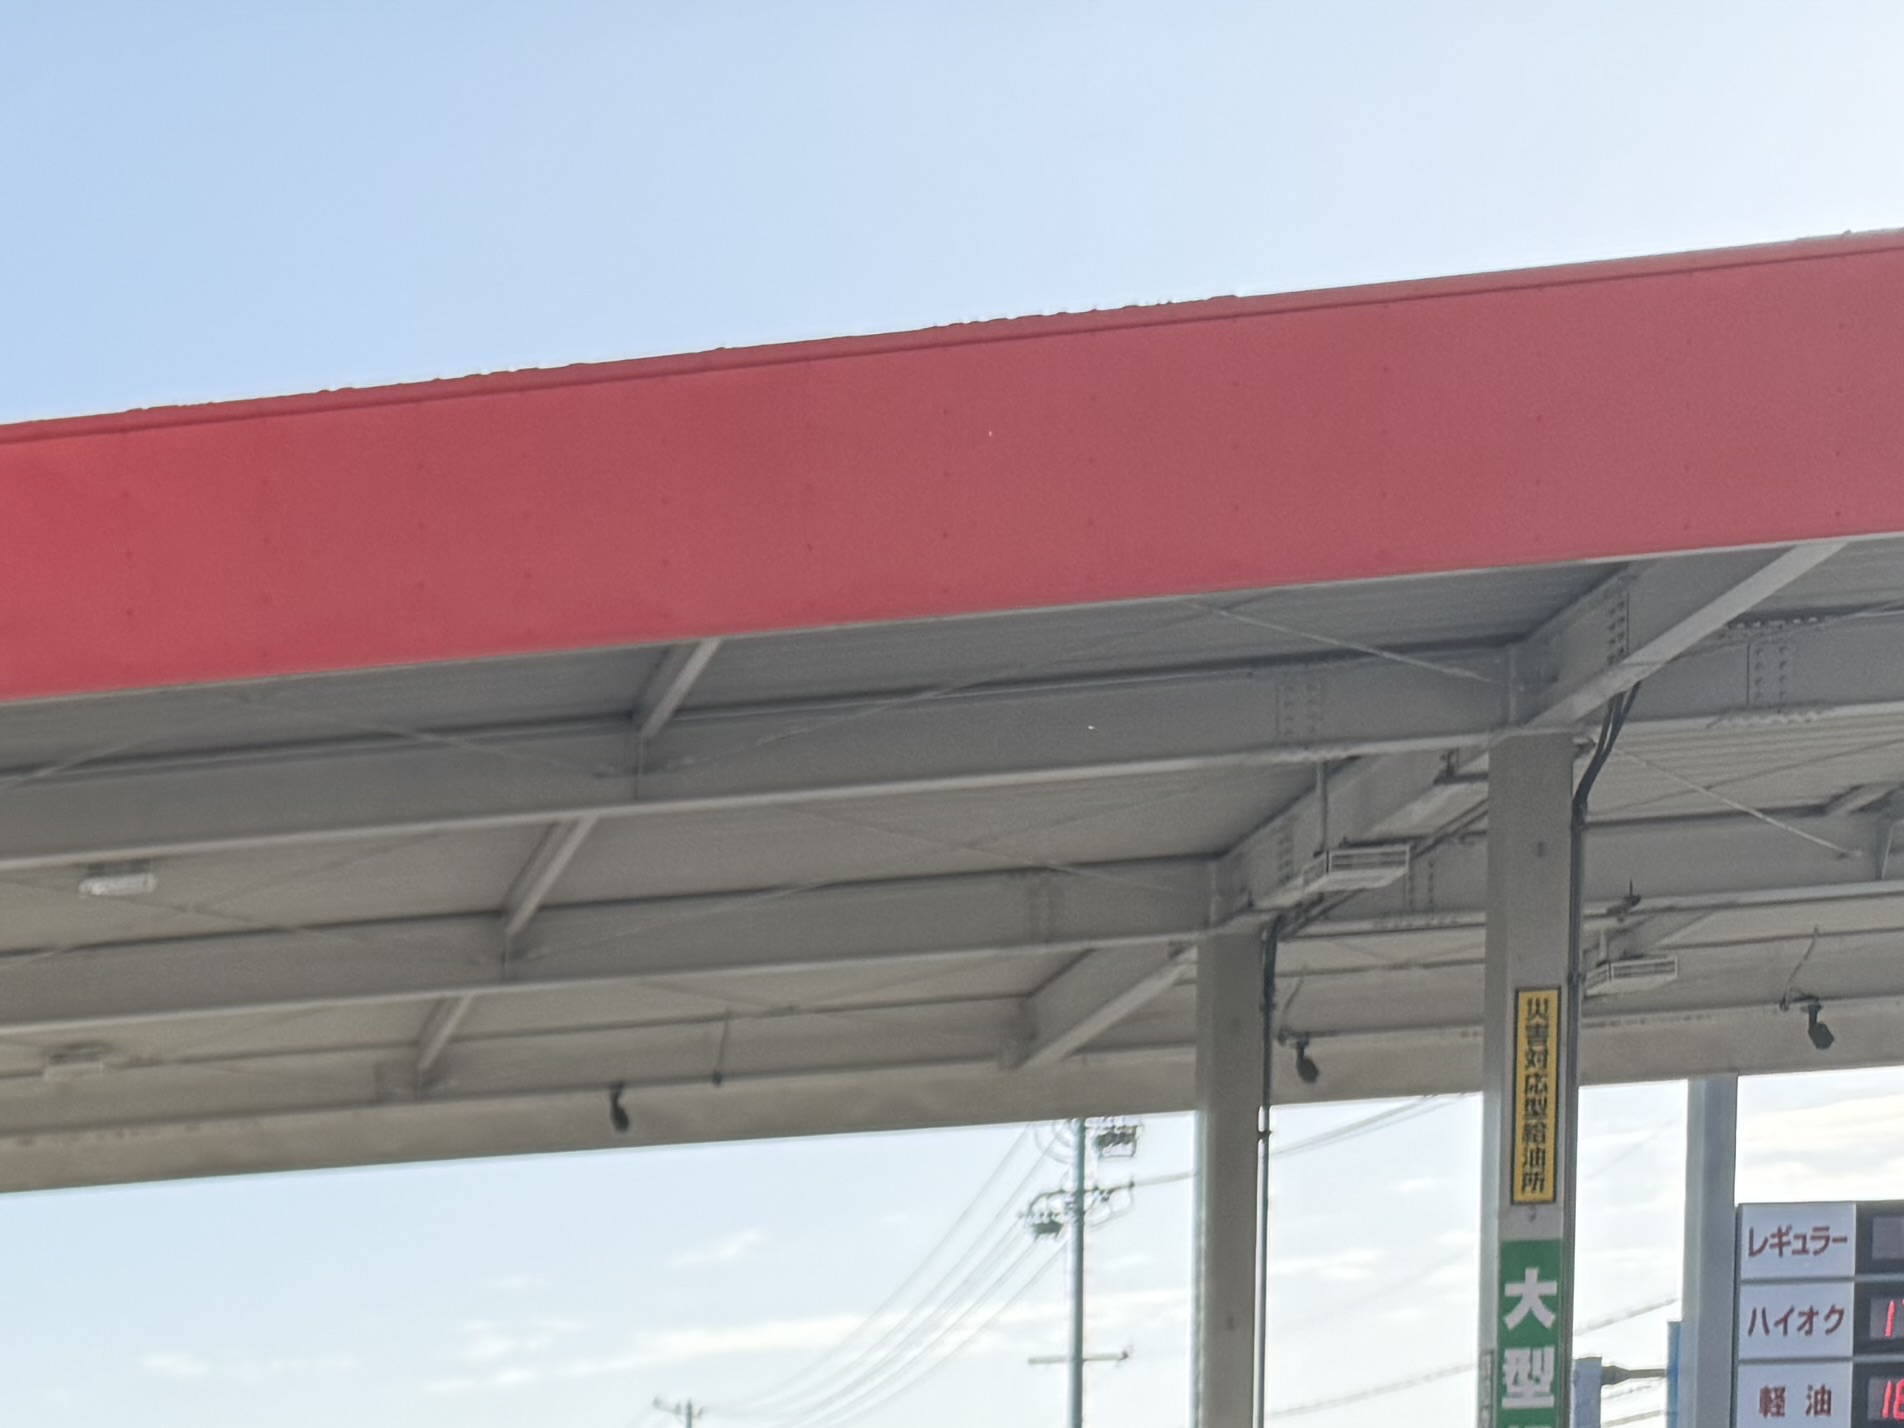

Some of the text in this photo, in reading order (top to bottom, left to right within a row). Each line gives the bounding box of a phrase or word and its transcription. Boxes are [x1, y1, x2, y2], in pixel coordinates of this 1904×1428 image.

[1520, 997, 1550, 1194] 災害対応型給油所
[1748, 1225, 1848, 1258] レギュラー
[1748, 1304, 1845, 1337] ハイオク
